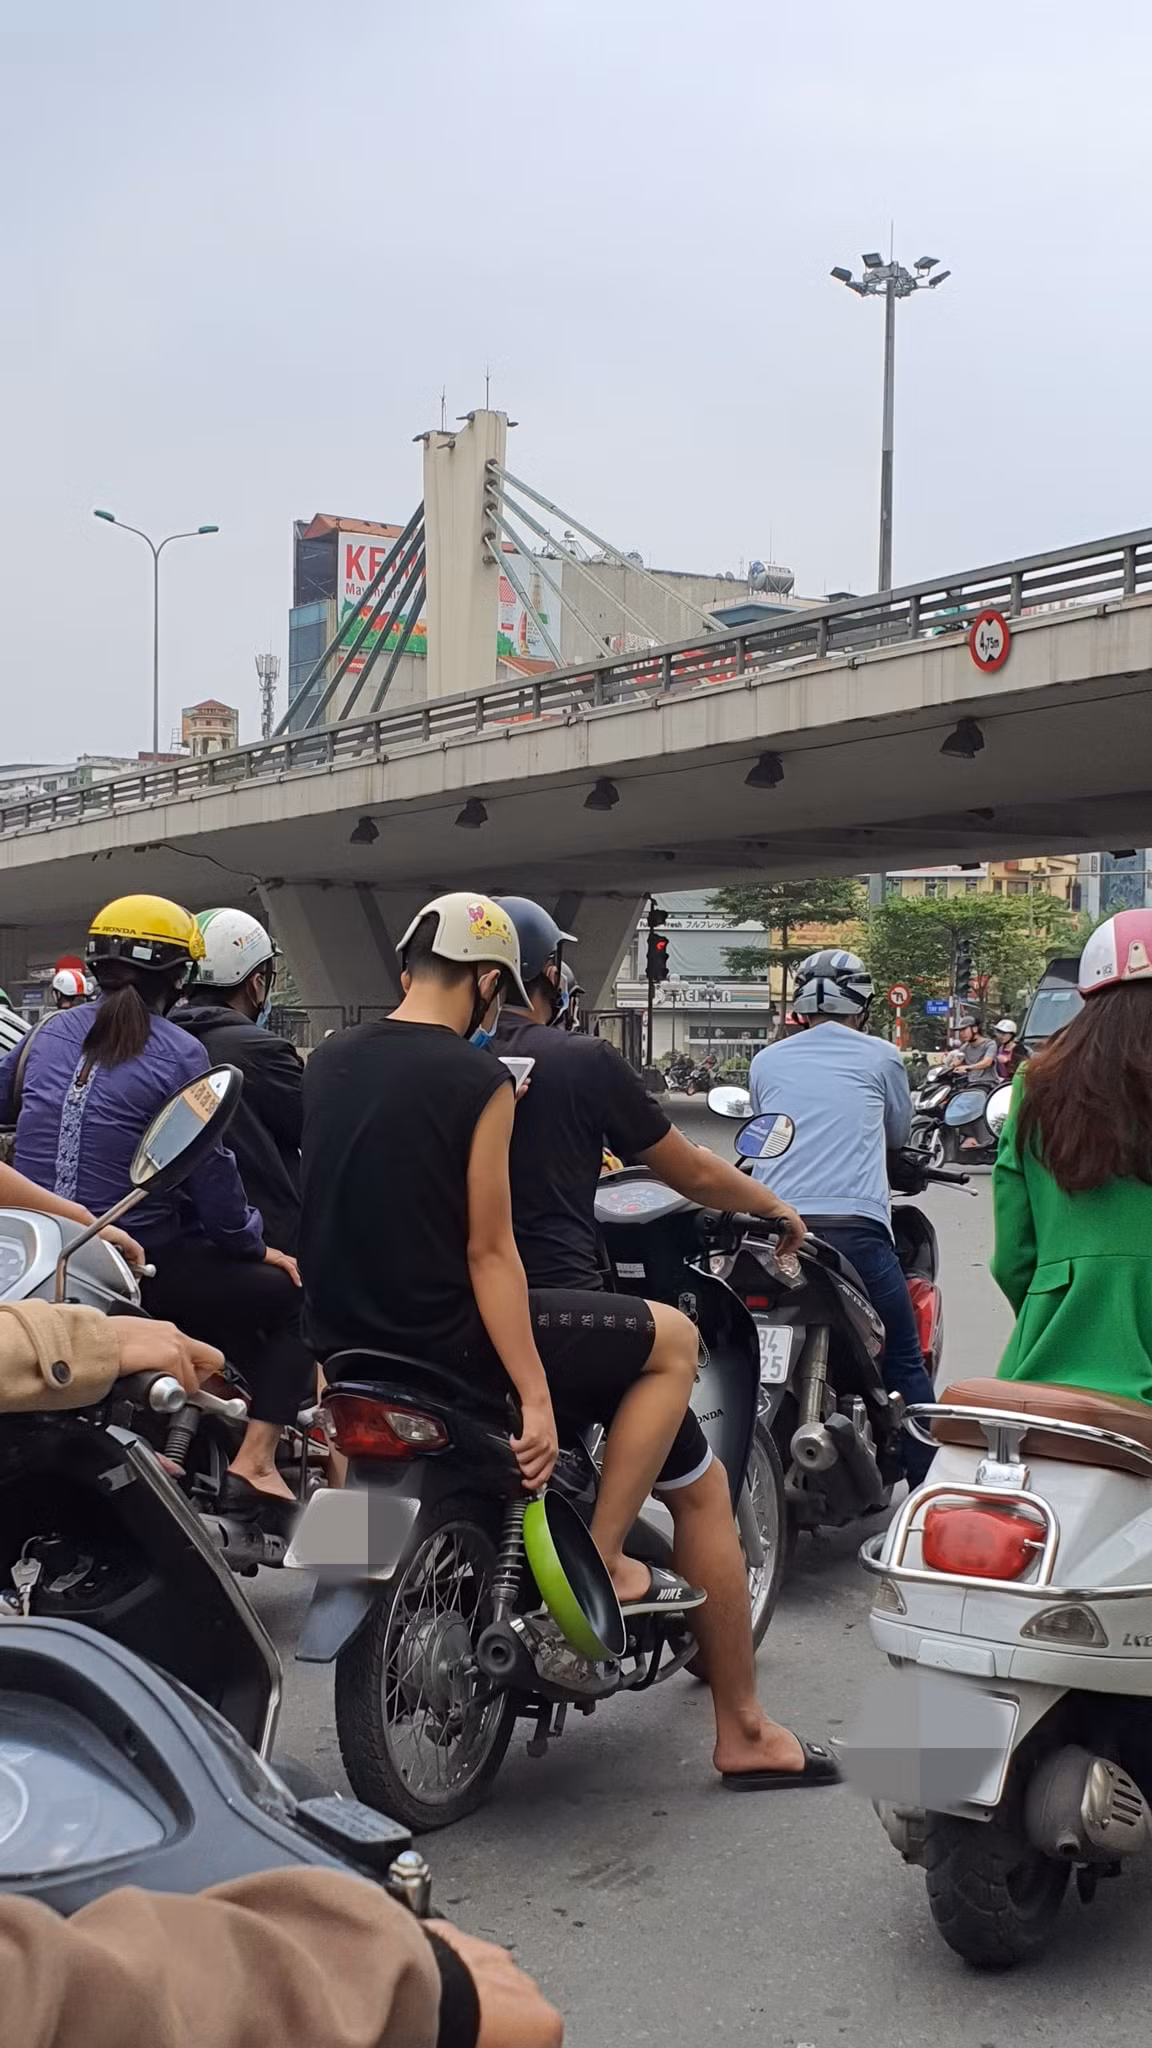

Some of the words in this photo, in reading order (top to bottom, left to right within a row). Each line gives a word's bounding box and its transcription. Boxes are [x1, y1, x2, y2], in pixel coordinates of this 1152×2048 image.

[103, 926, 137, 935] HONDA
[696, 1408, 724, 1425] ONDA
[656, 1587, 683, 1600] NIKE
